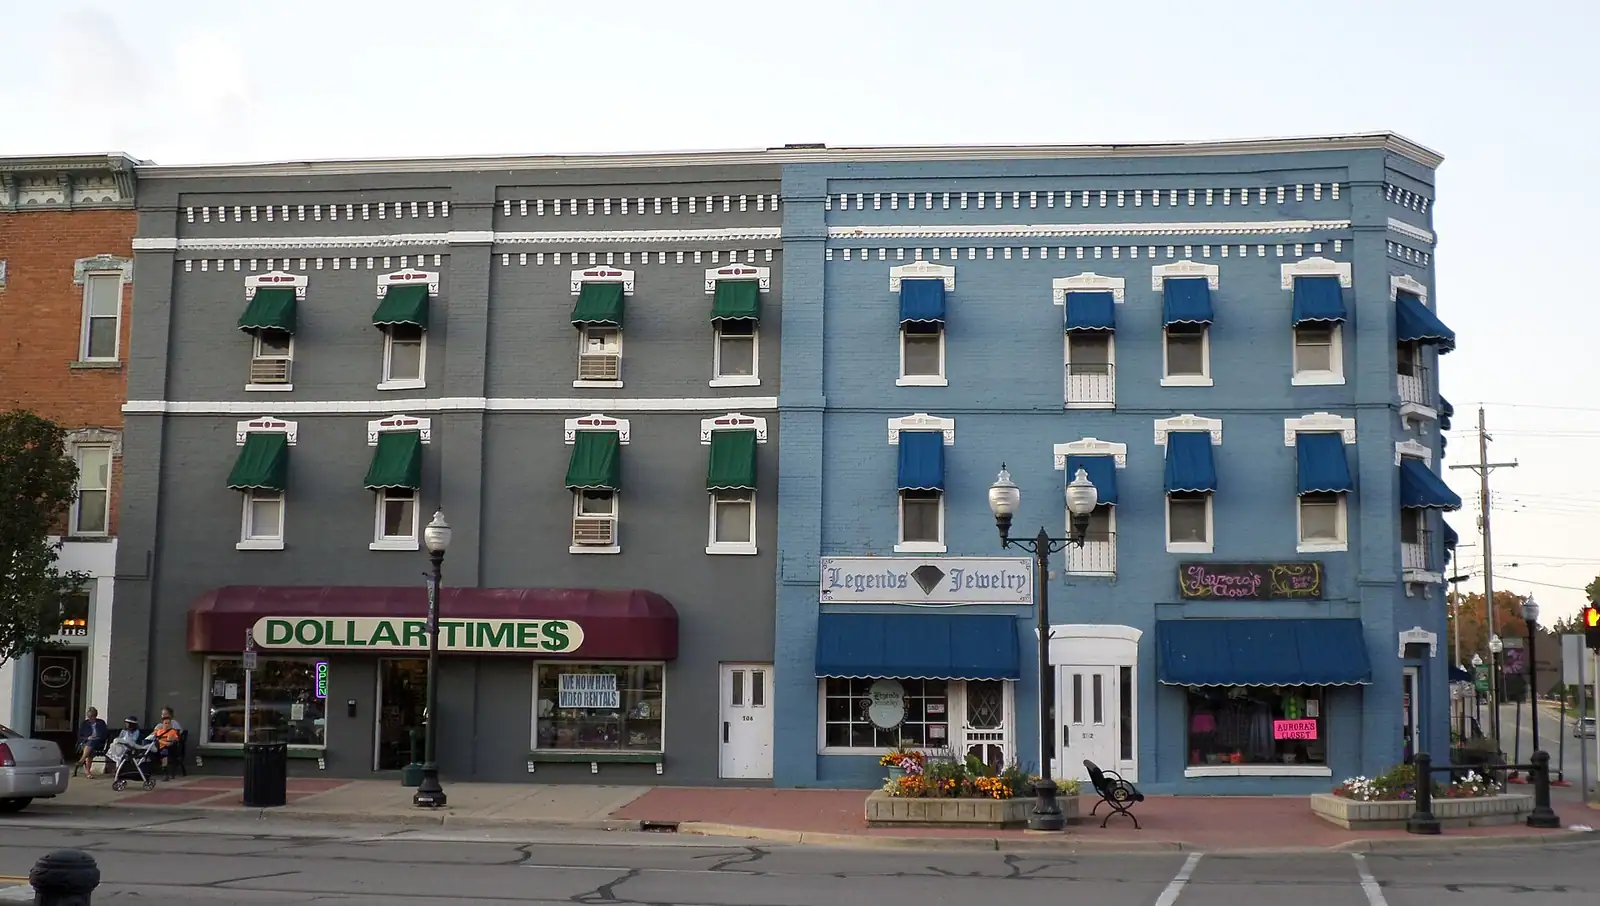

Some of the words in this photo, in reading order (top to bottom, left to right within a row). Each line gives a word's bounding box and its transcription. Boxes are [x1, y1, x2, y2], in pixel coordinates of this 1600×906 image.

[827, 567, 909, 592] Legends
[949, 568, 1026, 593] Jewelry
[1188, 566, 1261, 589] Aurora's
[1212, 580, 1259, 597] Closet
[265, 619, 428, 647] DOLLAR
[438, 621, 569, 651] TIME$
[318, 664, 328, 696] OPEN
[562, 675, 574, 690] WE
[575, 675, 595, 690] NOW
[595, 675, 615, 690] HAVE
[560, 691, 582, 706] VIDEO
[583, 691, 617, 706] RENTALS
[1277, 722, 1315, 731] AURORA'S
[1281, 731, 1311, 739] CLOSET
